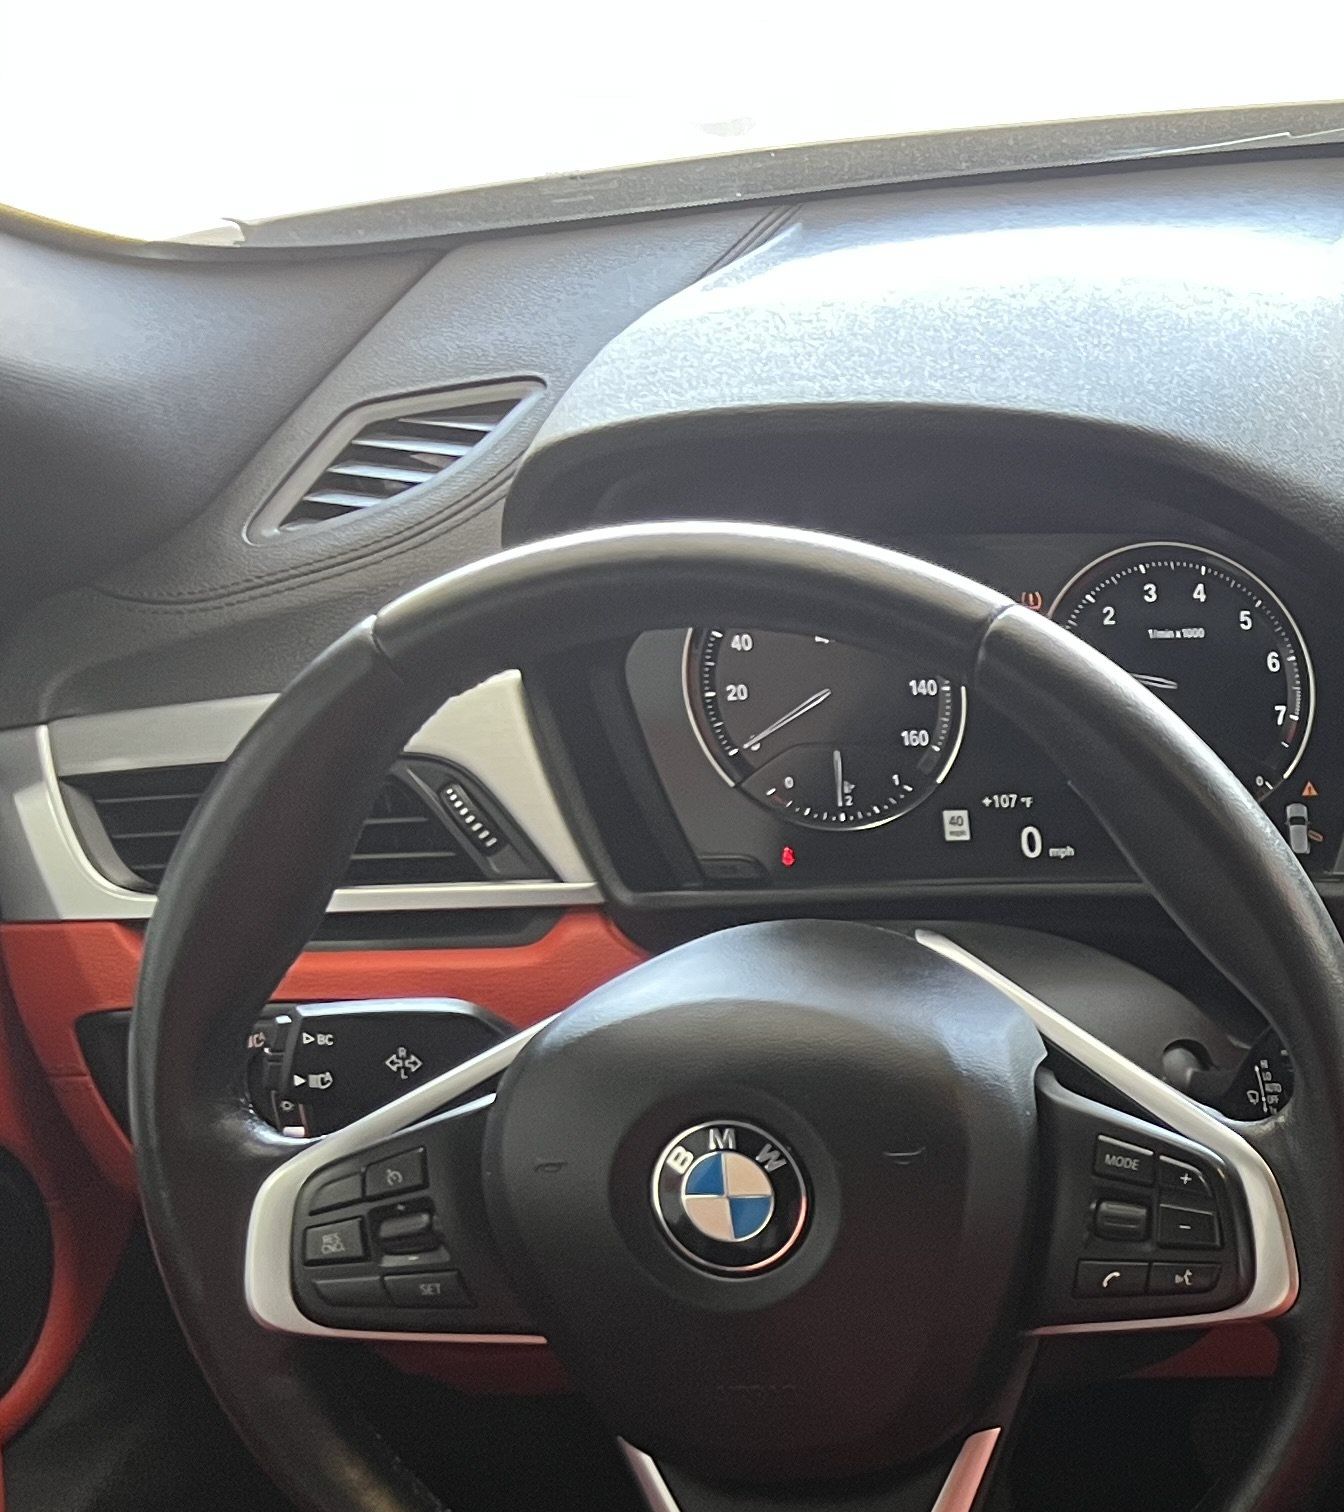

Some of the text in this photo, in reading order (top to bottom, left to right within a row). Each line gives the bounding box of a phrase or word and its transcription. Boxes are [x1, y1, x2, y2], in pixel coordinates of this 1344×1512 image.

[1143, 583, 1157, 603] 3
[1192, 583, 1206, 602] 4
[1102, 606, 1116, 625] 2
[1239, 610, 1253, 630] 5
[730, 633, 753, 651] 40
[1266, 651, 1281, 672] 6
[725, 684, 748, 701] 20
[908, 679, 938, 696] 140
[1274, 705, 1287, 725] 7
[901, 730, 929, 747] 160
[982, 794, 1017, 808] +107
[949, 816, 964, 827] 40
[1021, 826, 1042, 858] 0
[317, 1034, 334, 1046] BC
[666, 1127, 787, 1175] BMW
[1105, 1153, 1139, 1171] MODE
[419, 1283, 441, 1295] SET
